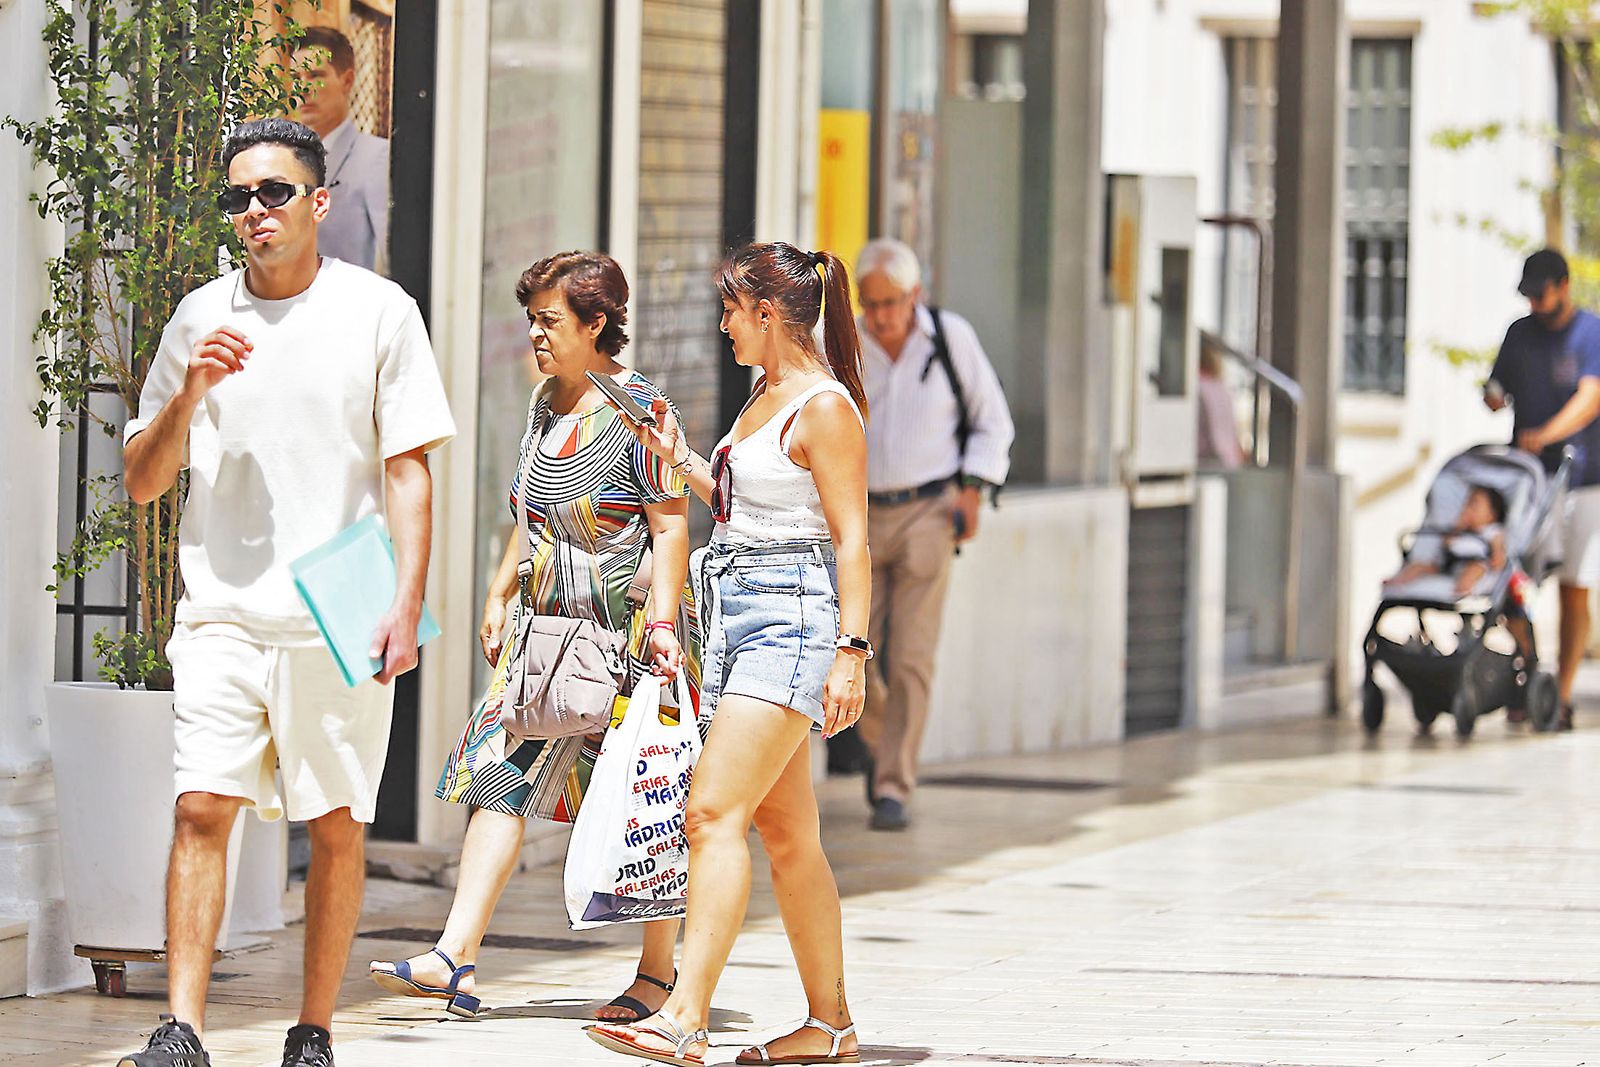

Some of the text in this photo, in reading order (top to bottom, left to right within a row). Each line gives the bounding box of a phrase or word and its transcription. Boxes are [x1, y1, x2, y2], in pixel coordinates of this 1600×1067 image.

[632, 775, 670, 794] ERIAS
[614, 867, 676, 897] GALERIAS
[651, 871, 688, 901] MAD
